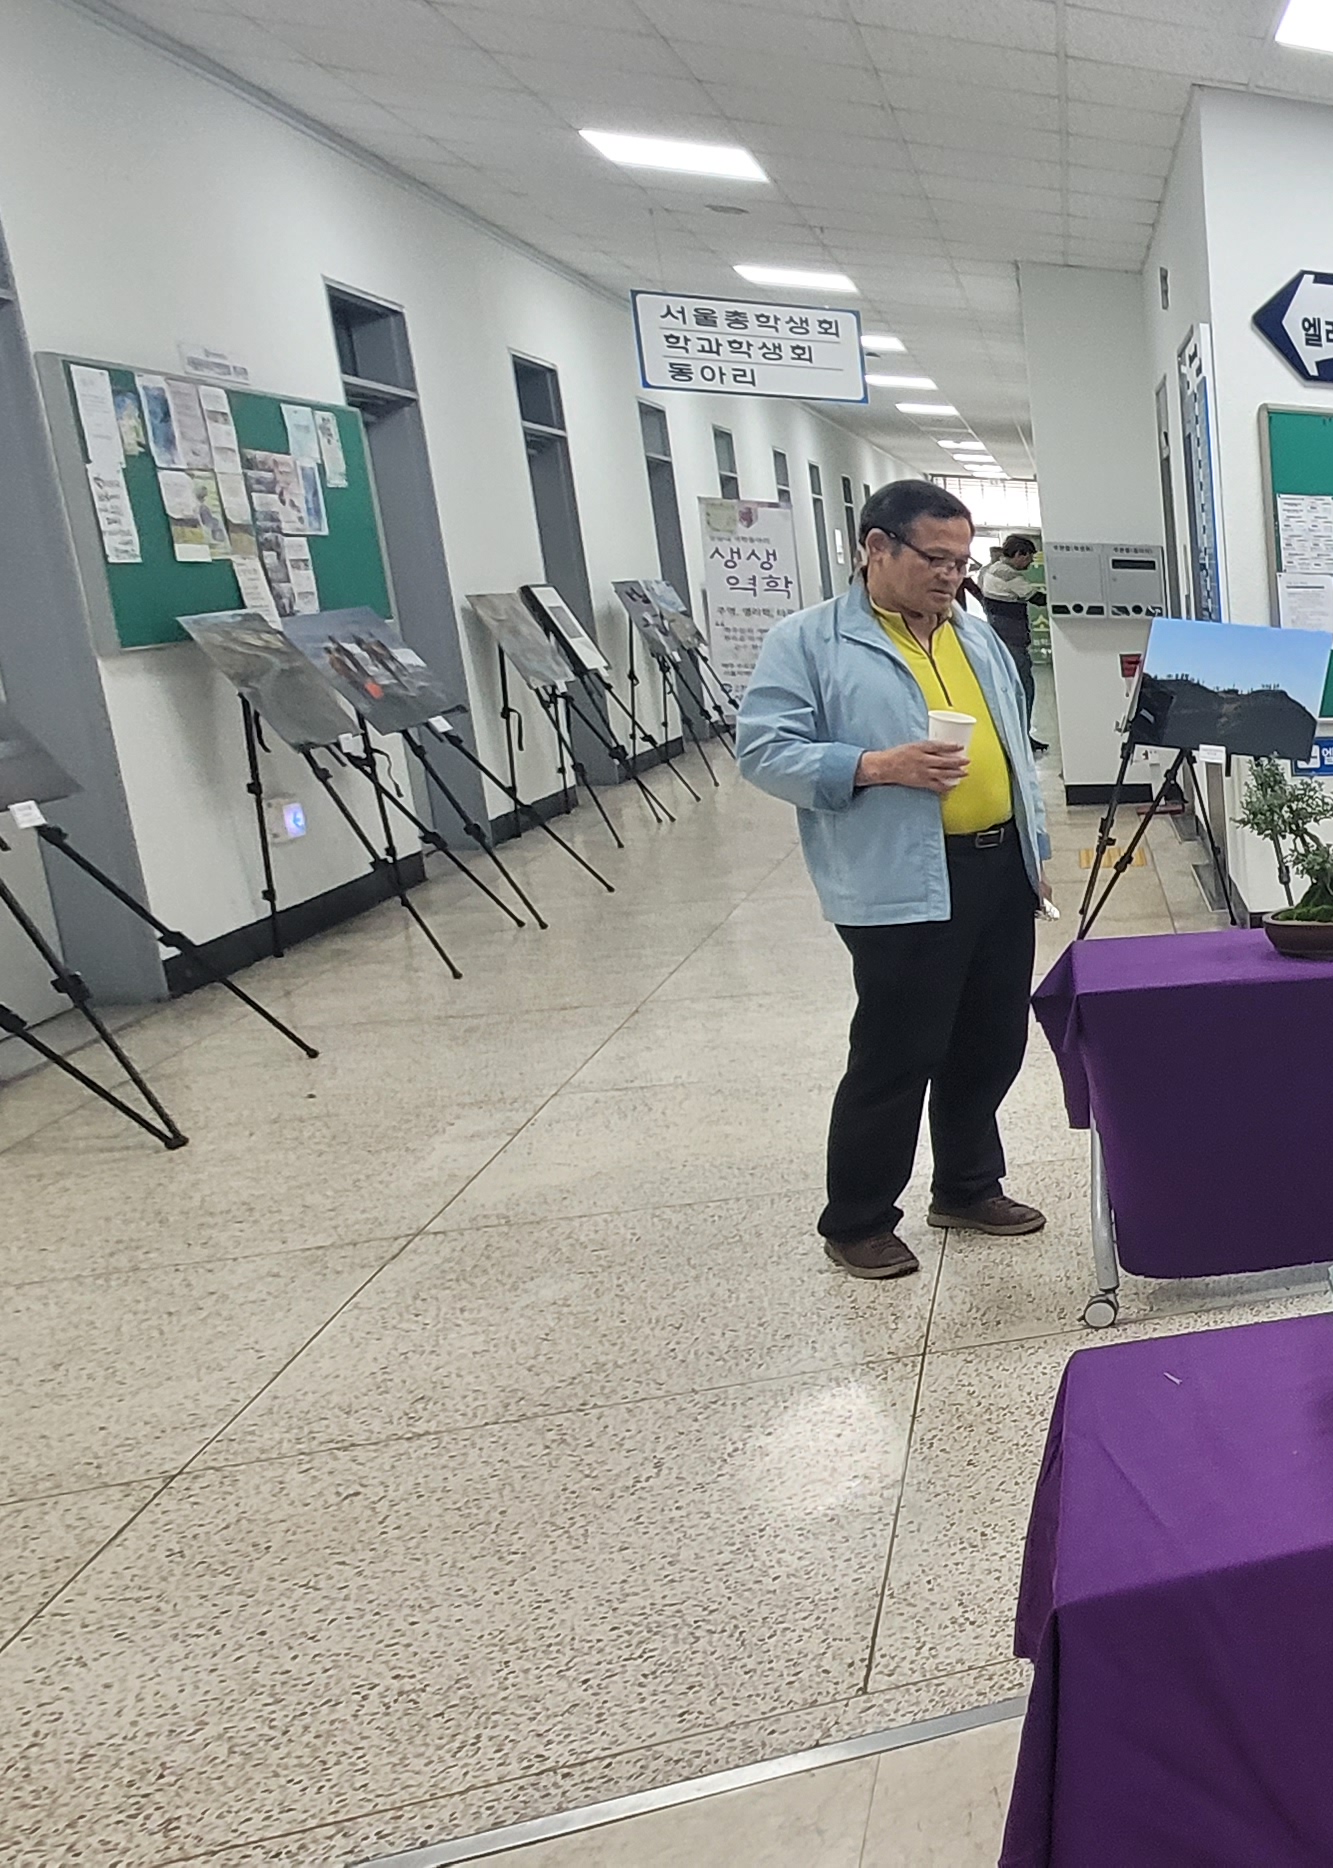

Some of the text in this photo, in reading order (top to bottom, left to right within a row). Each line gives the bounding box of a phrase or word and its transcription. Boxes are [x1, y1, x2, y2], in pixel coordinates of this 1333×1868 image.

[659, 304, 841, 338] 서울총학생회
[663, 333, 813, 364] 학과학생회
[668, 361, 756, 387] 동아리
[709, 547, 778, 571] 생생
[726, 575, 794, 600] 역학
